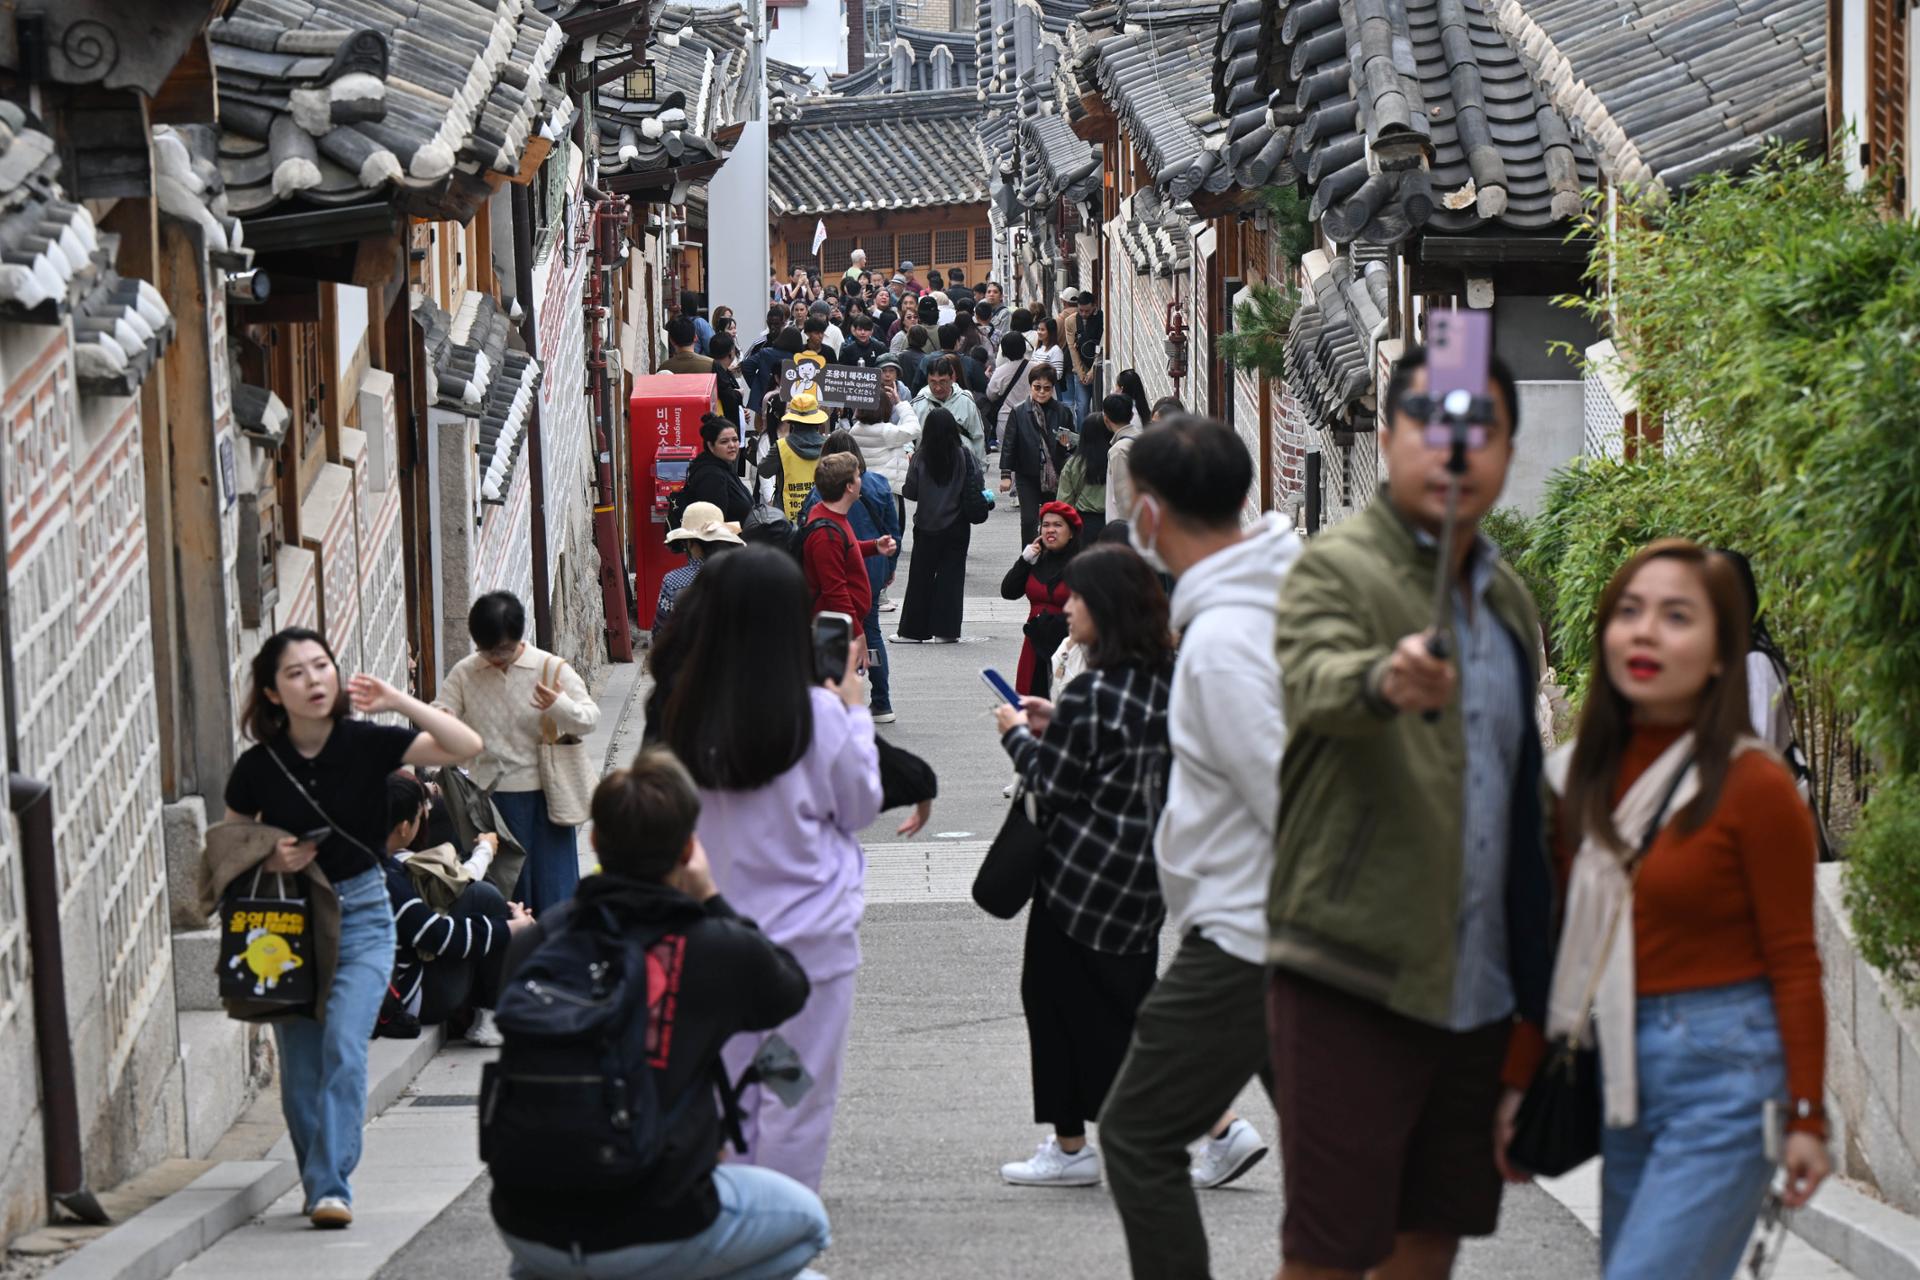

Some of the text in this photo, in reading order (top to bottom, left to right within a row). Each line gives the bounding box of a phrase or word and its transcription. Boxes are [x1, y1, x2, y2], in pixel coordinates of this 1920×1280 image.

[825, 369, 878, 382] 조용히 해주세요
[824, 378, 843, 386] Please
[855, 381, 877, 390] quietly
[824, 385, 876, 396] 静かにしてください
[673, 407, 682, 448] Emergency
